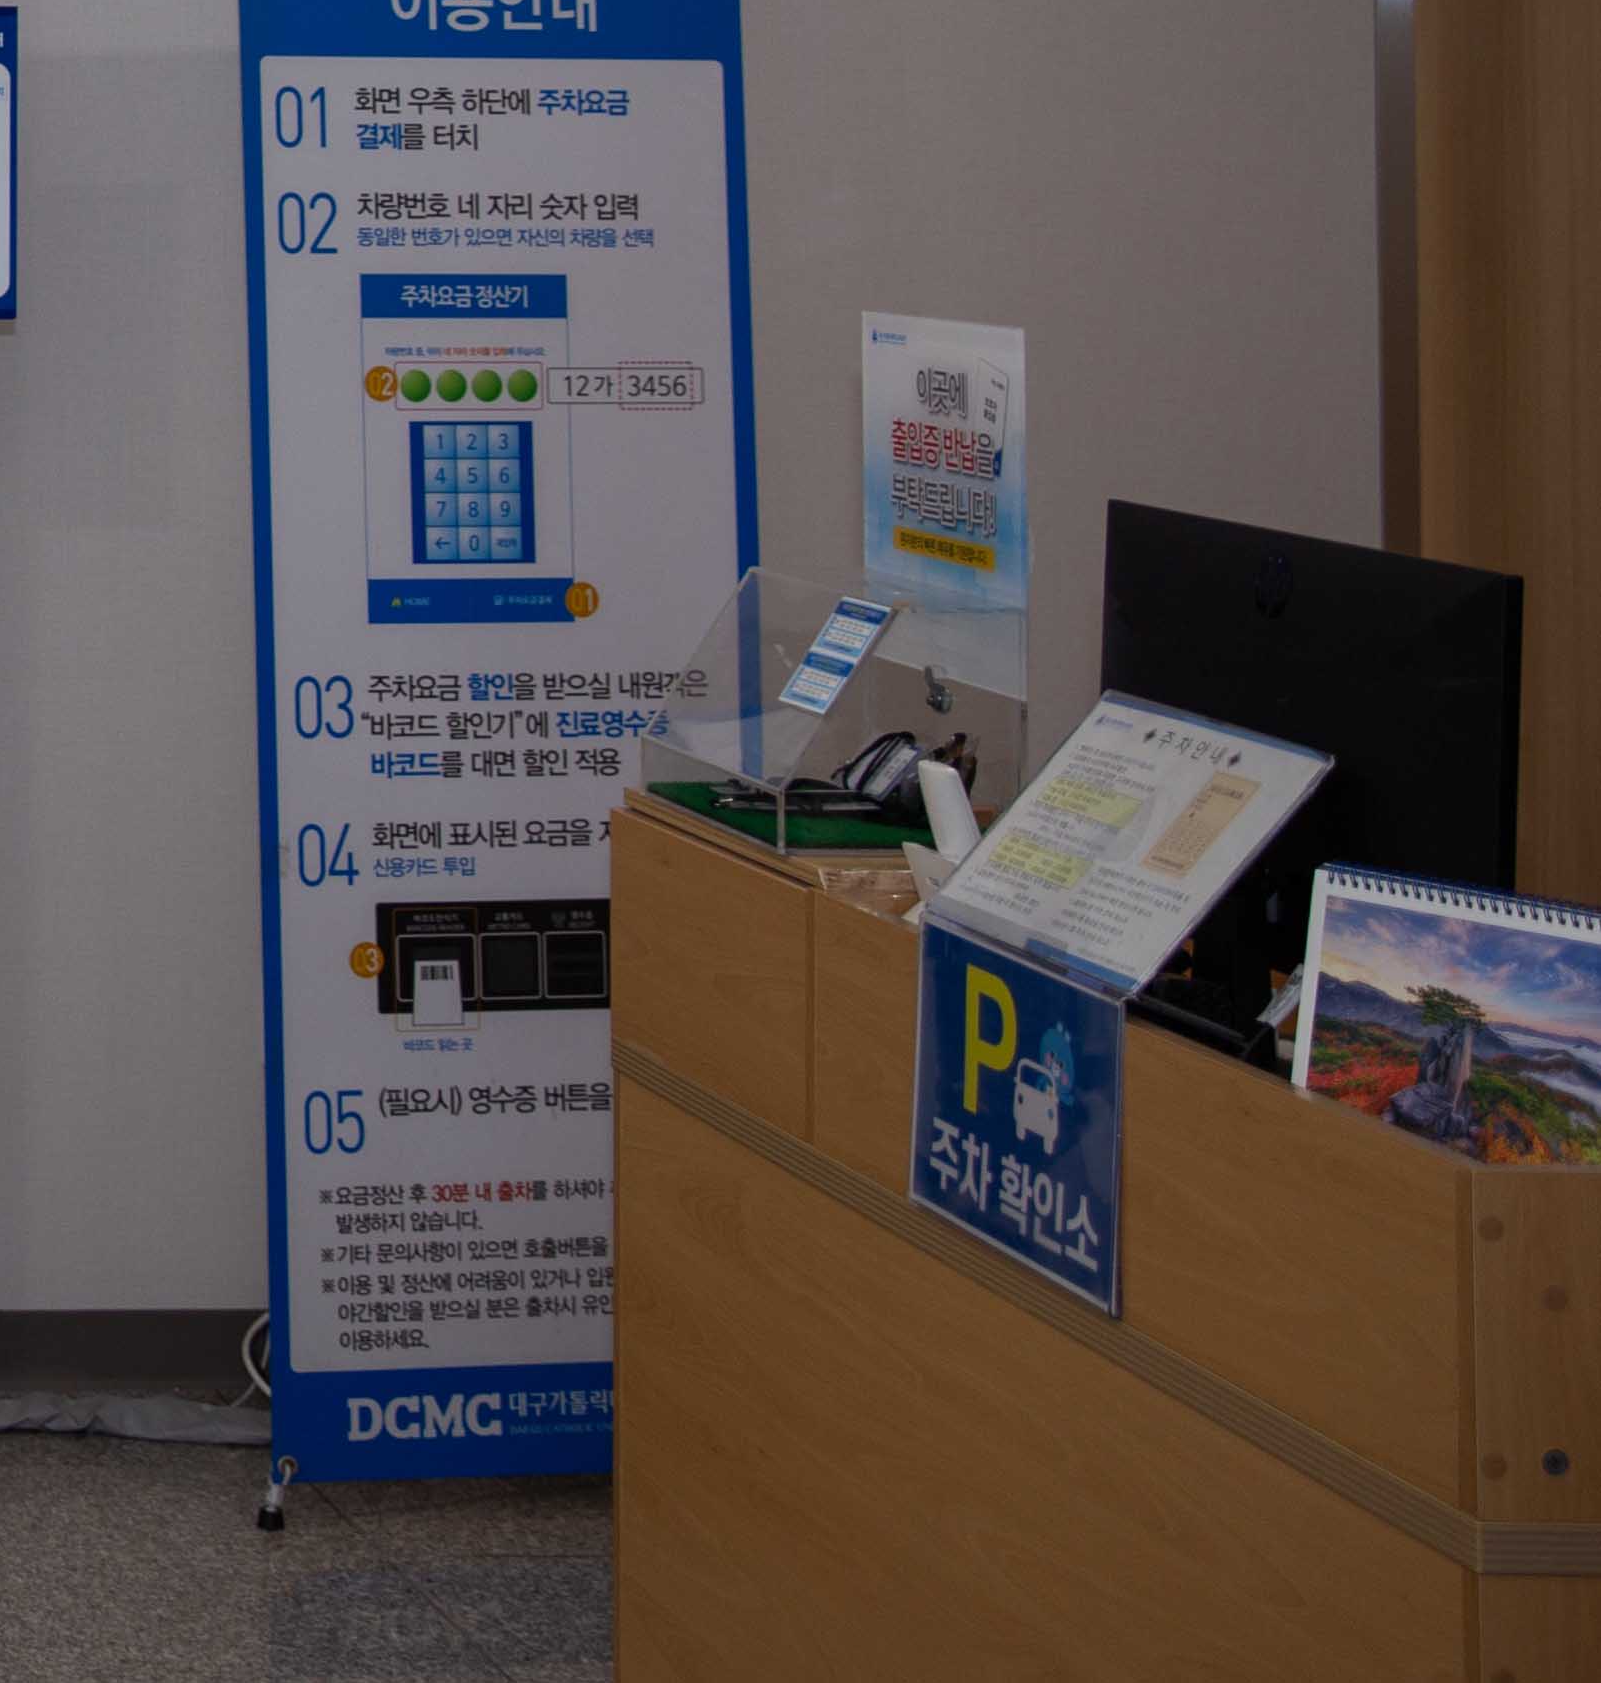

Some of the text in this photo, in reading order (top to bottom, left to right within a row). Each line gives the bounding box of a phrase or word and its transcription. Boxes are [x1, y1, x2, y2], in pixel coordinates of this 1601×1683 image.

[276, 87, 630, 148] 01 화면 우측 하단에 주차요금
[356, 124, 478, 151] 결제를 터치
[278, 193, 639, 253] 02 차량번호 네 자리 숫자 입력
[357, 228, 654, 248] 동일한 번호가 있으면 자신의 차량을 선택
[627, 376, 687, 396] 3456
[917, 367, 968, 418] 이곳에
[891, 417, 994, 478] 출입증 반납을
[295, 673, 611, 739] 03 주차요금 할인을 받으실
[371, 748, 621, 778] 바코드를 대면 할인 적용
[298, 820, 592, 886] 04 화면에 표시된 요금을
[373, 858, 476, 877] 신용카드 투입
[963, 962, 1017, 1115] P
[304, 1082, 611, 1154] 05 (필요시) 영수증 버튼을
[432, 1179, 603, 1203] 30분 내 출차를 하셔야
[930, 1117, 1098, 1272] 주차 확인소
[336, 1211, 484, 1234] 발생하지 않습니다.
[377, 1236, 607, 1263] 문의사항이 있으면 호출버튼을
[401, 1269, 580, 1293] 정산에 어려움이 있거나
[339, 1329, 429, 1352] 이용하세요.
[347, 1390, 613, 1441] DCMC 대구가톨릭
